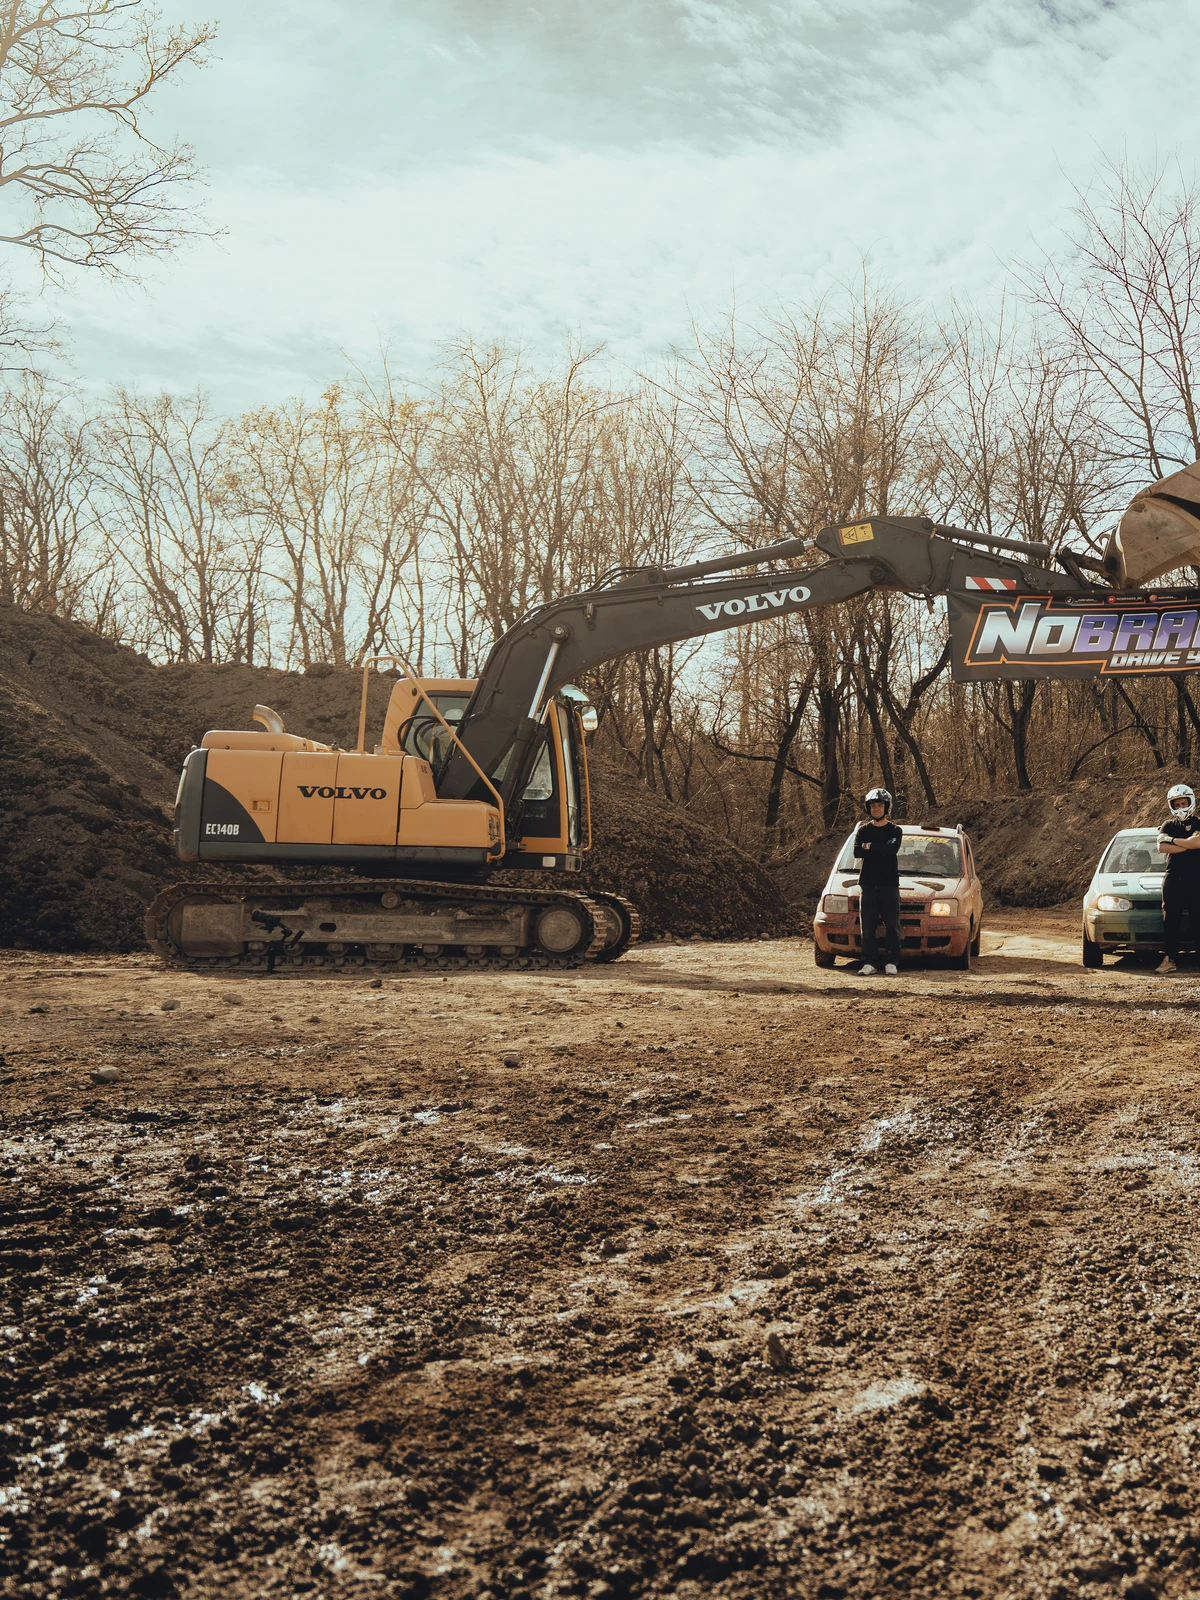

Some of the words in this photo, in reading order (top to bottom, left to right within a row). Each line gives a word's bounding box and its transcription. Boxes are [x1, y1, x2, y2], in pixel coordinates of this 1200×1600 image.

[696, 586, 811, 620] VOLVO
[1109, 651, 1182, 668] DRIVE
[297, 785, 387, 800] VOLVO
[205, 823, 240, 836] EC140B
